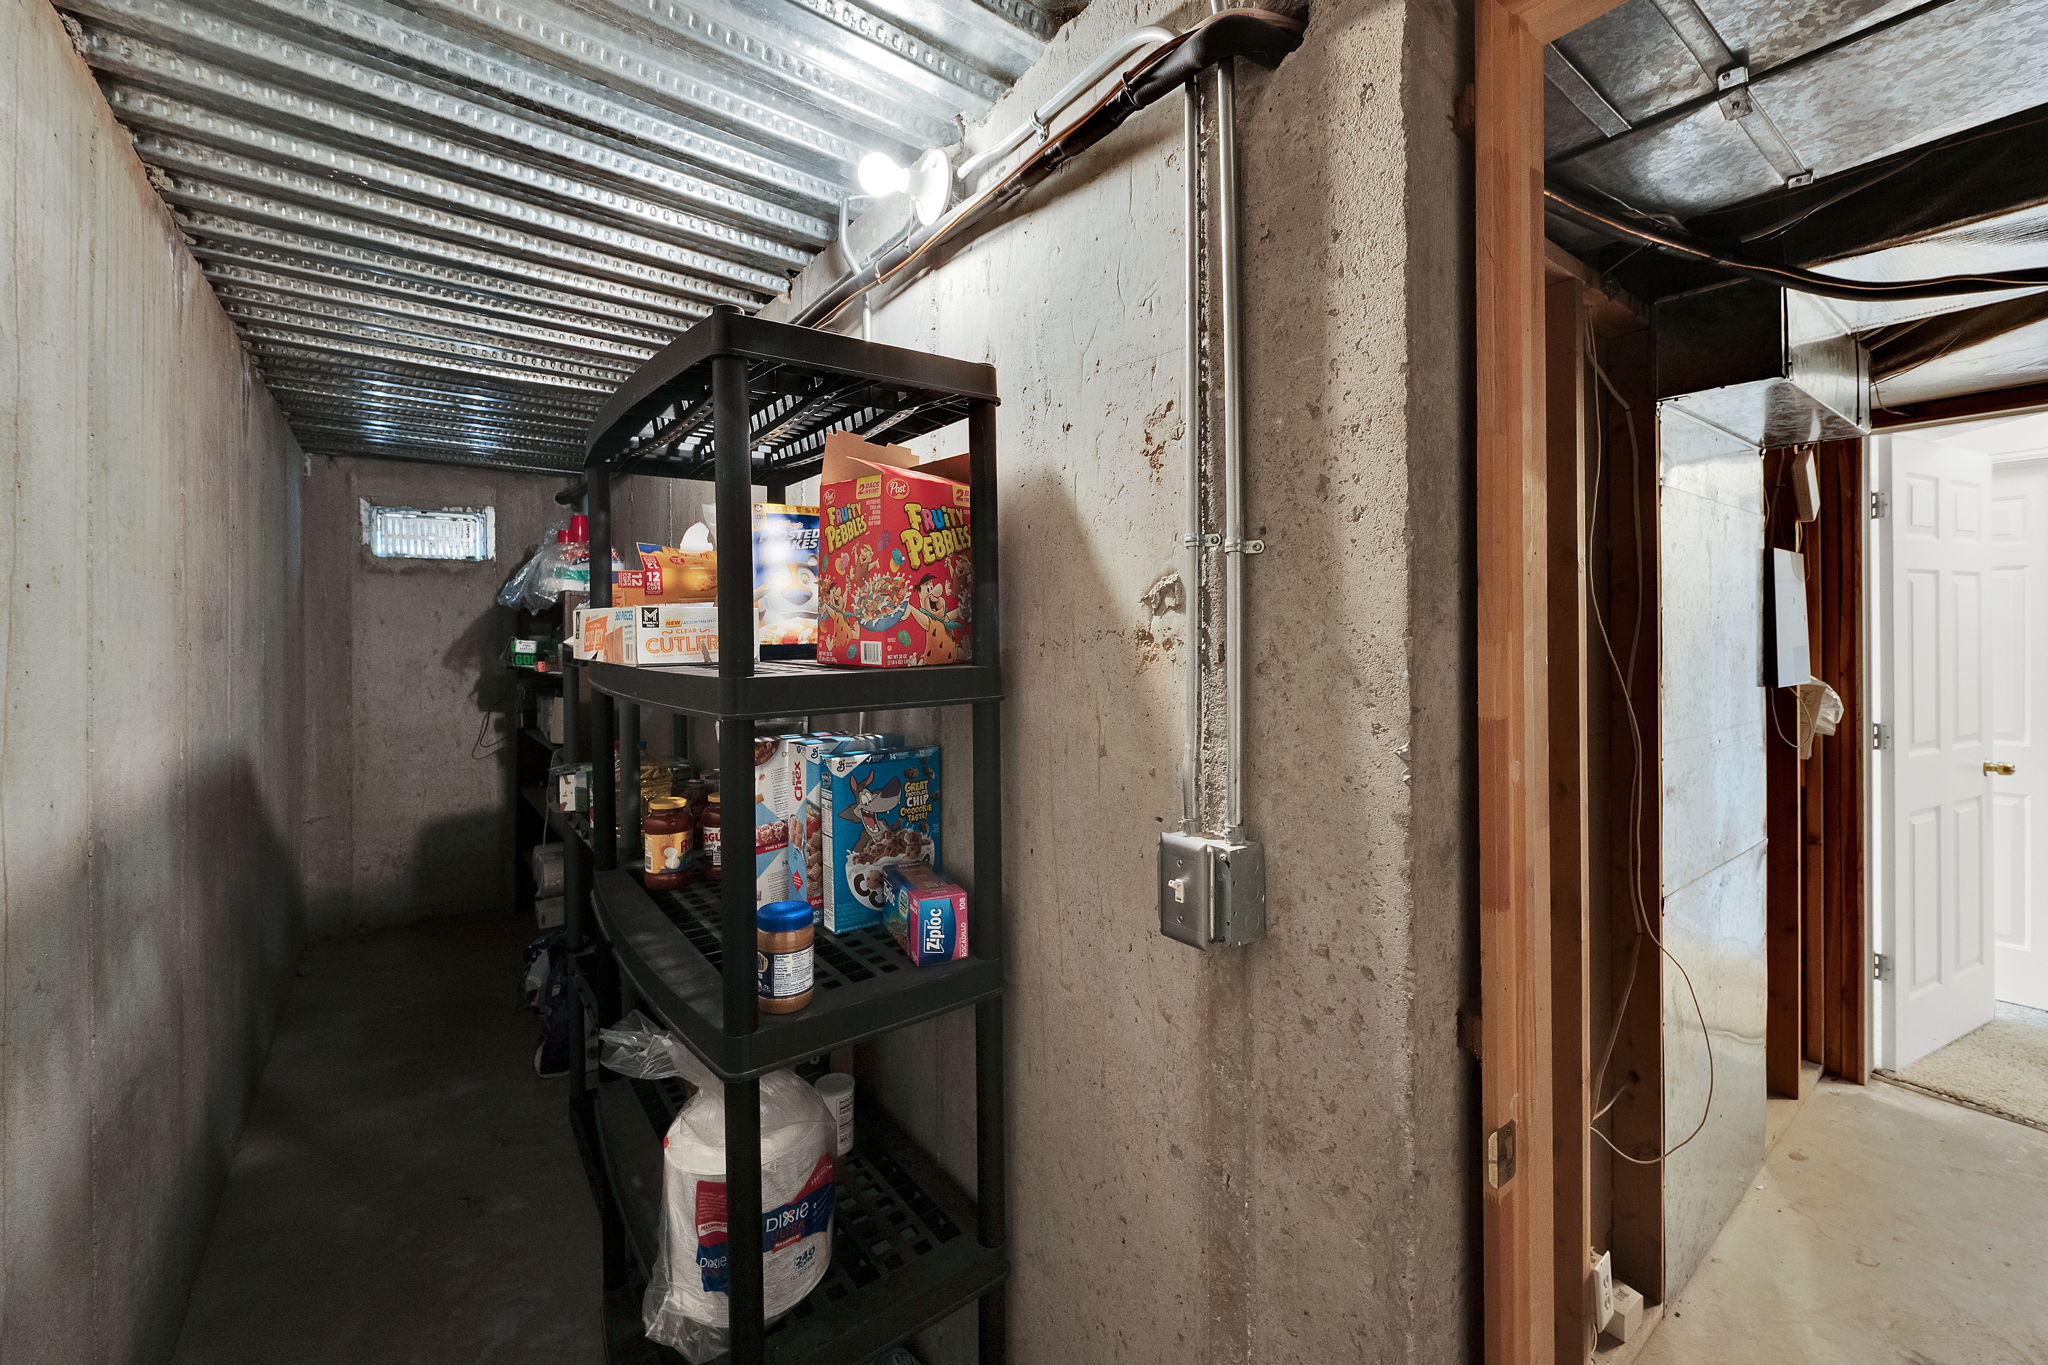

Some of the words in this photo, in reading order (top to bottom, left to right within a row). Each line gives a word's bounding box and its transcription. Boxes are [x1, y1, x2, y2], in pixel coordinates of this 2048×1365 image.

[890, 481, 907, 495] Post
[825, 514, 867, 552] PEBBLES
[900, 525, 971, 571] PEBBLES
[646, 571, 661, 582] 12
[646, 634, 719, 654] CUTLER
[794, 761, 803, 801] Chex
[904, 780, 929, 792] GREAT
[906, 795, 929, 807] CHIP
[926, 908, 945, 950] Ziploc
[796, 1246, 815, 1267] 240
